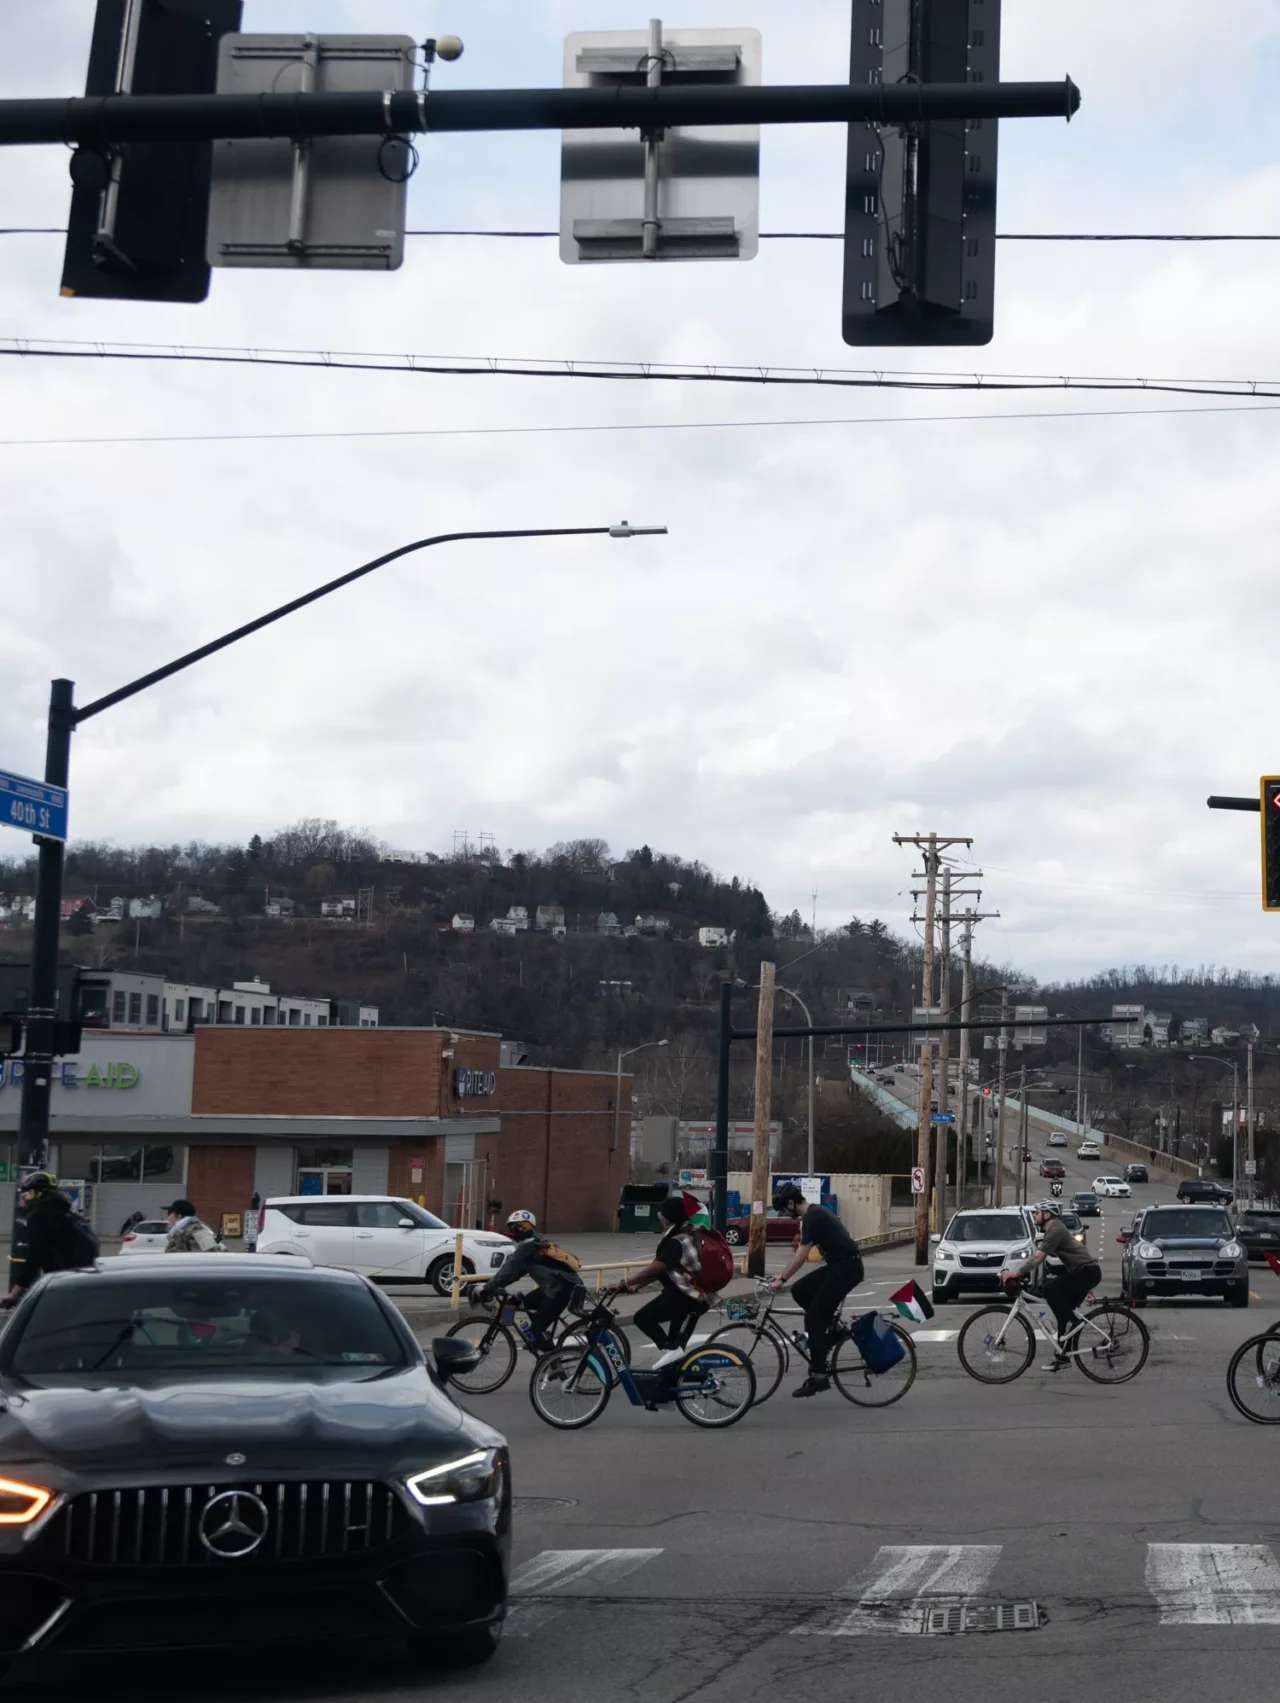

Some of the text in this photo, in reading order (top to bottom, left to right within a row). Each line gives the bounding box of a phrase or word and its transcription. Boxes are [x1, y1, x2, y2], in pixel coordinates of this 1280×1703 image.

[11, 800, 36, 825] 40th
[39, 807, 50, 829] St
[85, 1062, 138, 1088] AID
[467, 1070, 496, 1095] RITE AID
